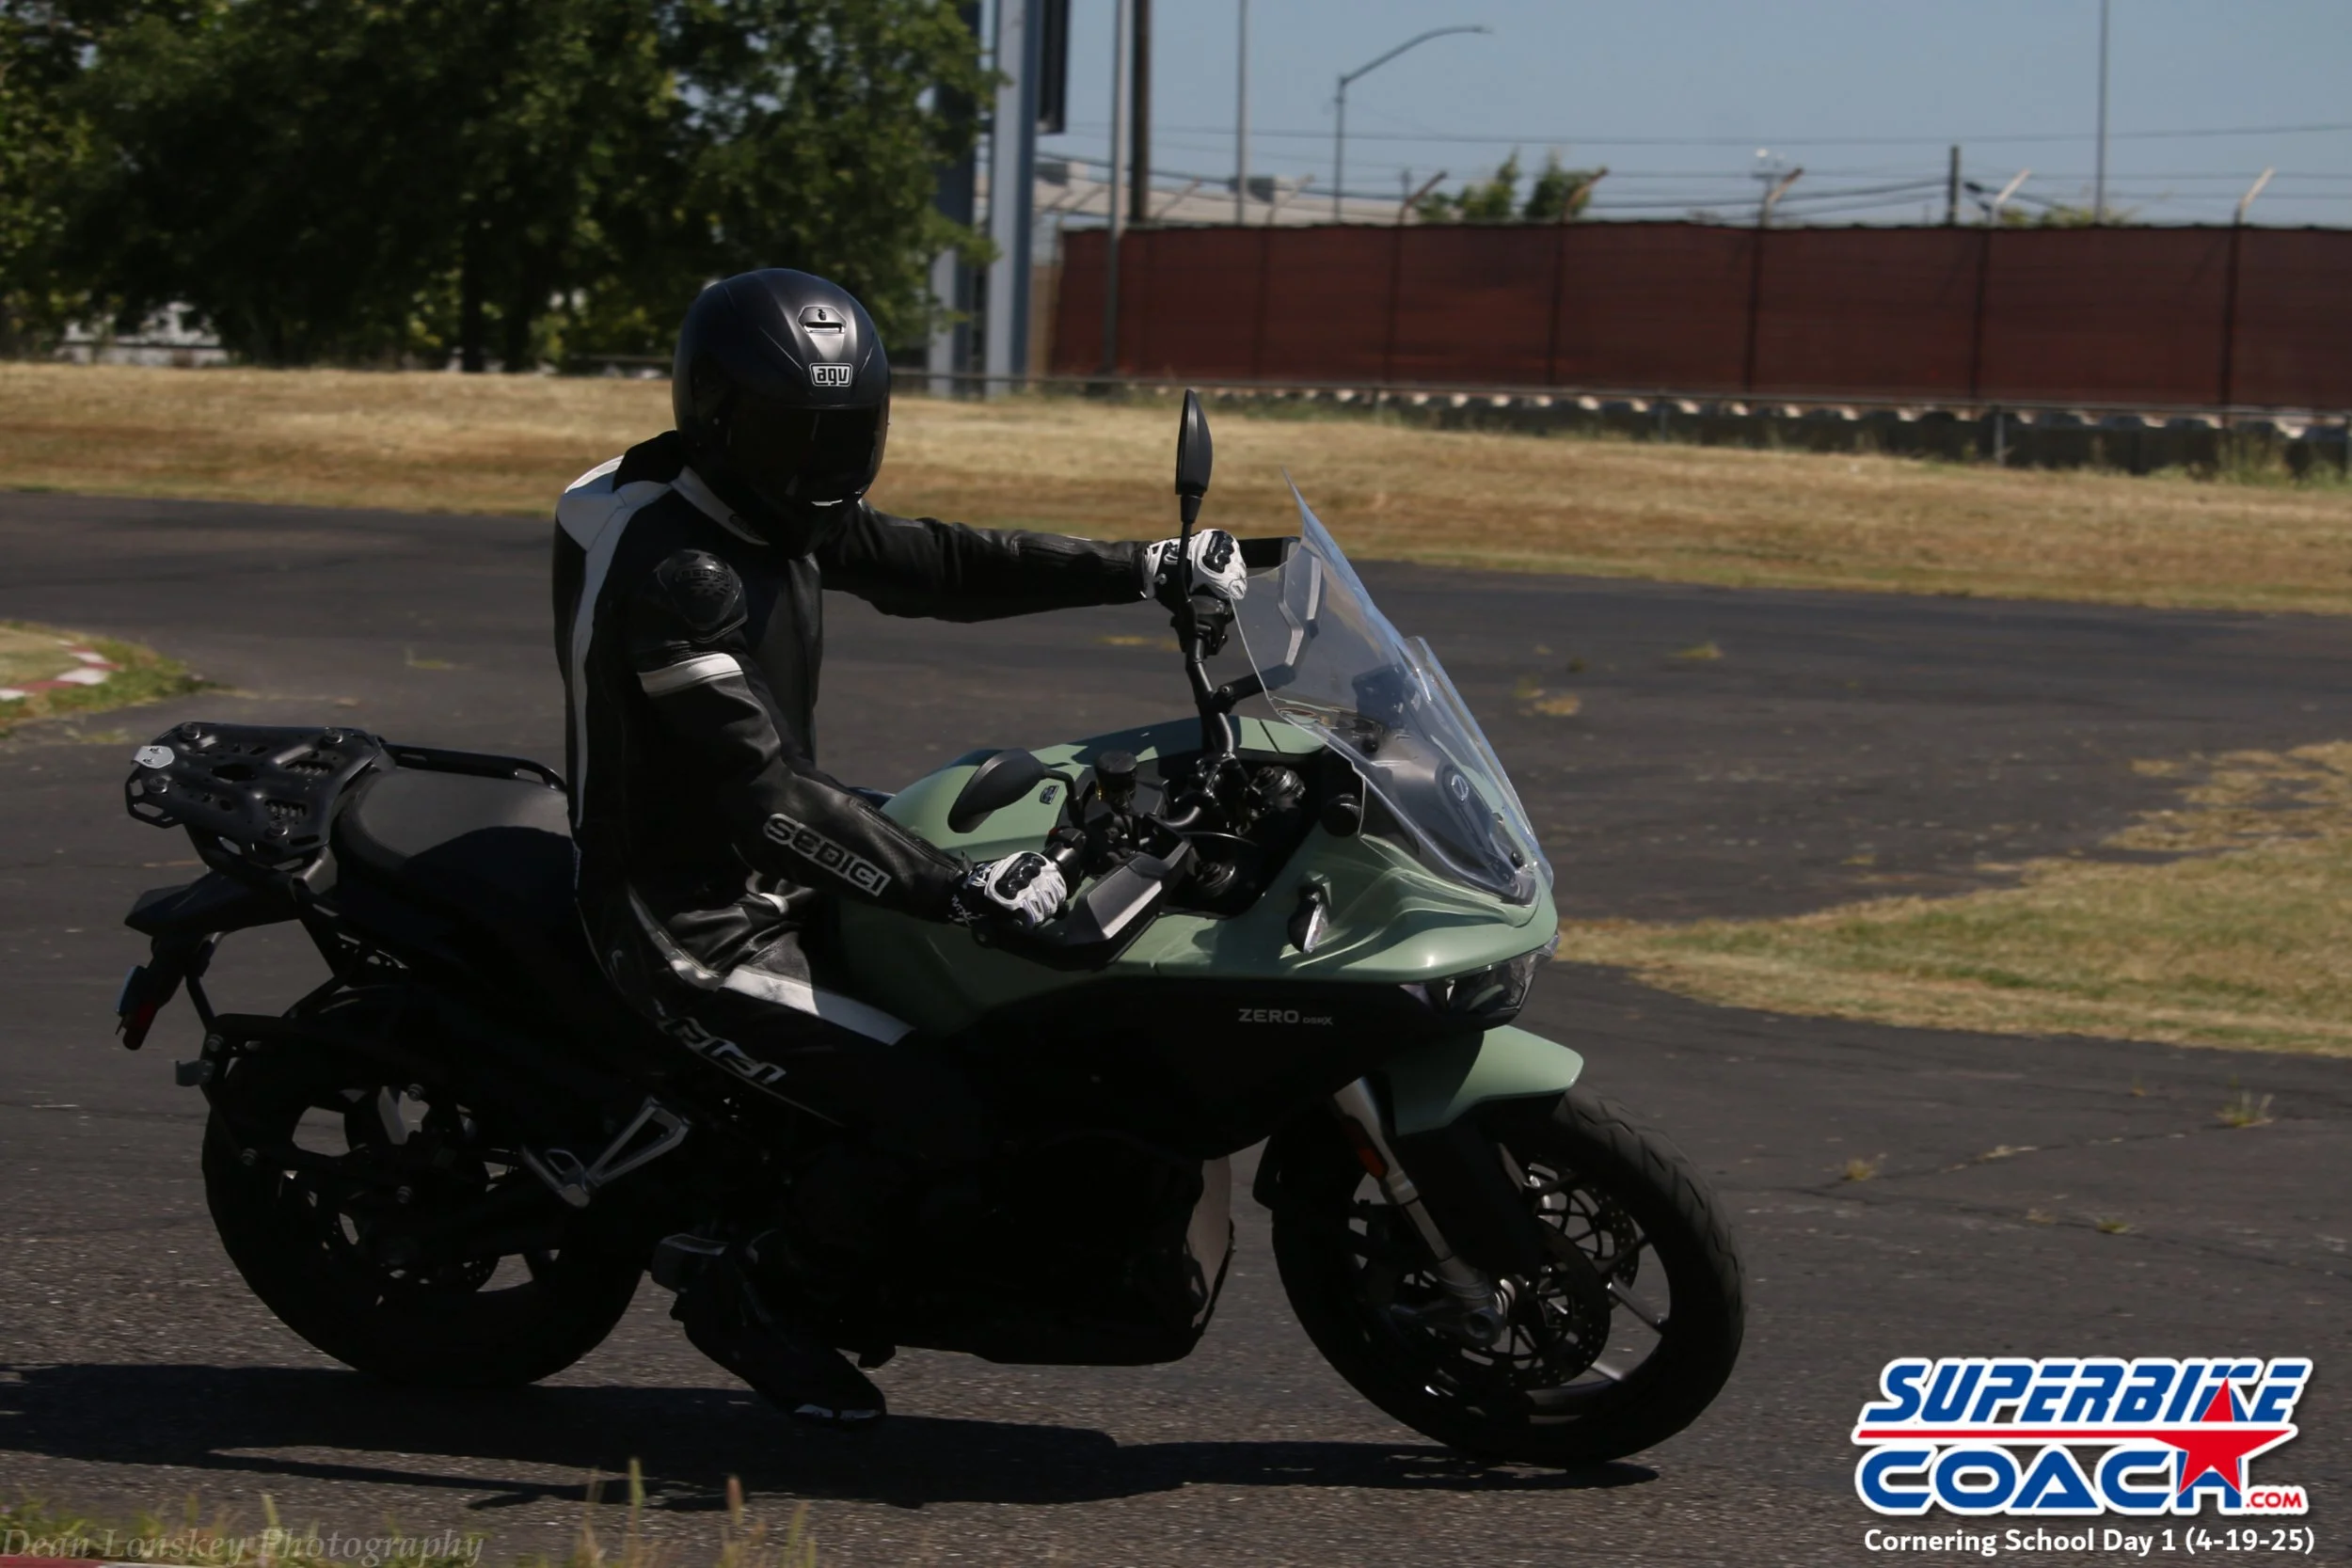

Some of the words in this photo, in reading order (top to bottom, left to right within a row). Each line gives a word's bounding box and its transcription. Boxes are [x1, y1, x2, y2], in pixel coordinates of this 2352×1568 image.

[817, 368, 848, 386] agv
[763, 813, 892, 896] SEDICI
[1238, 1008, 1299, 1024] ZERO
